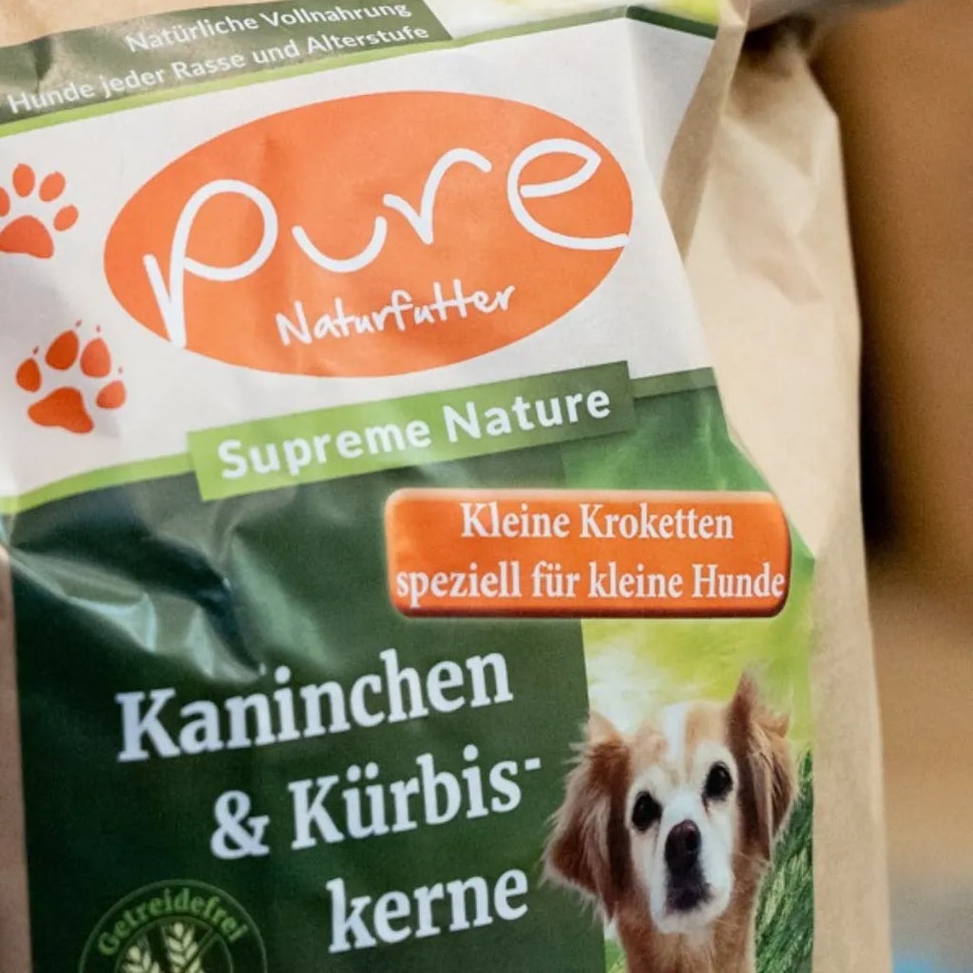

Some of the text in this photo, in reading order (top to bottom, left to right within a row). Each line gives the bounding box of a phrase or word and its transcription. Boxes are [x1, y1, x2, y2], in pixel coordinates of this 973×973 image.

[10, 79, 96, 114] Hunde
[99, 66, 165, 102] jeder
[171, 50, 246, 82] Rasse
[251, 37, 302, 65] und
[305, 24, 430, 56] Alterstufe
[126, 12, 260, 55] Natürliche
[274, 280, 516, 346] Naturfutter
[217, 386, 612, 481] Supreme Nature
[459, 502, 735, 541] Kleine Kroketten
[395, 560, 786, 610] speziell für kleine Hunde
[115, 648, 515, 763] Kaninchen
[209, 744, 542, 860] & Kürbis-
[96, 886, 249, 957] Getreidefrei
[327, 867, 529, 954] kerne
